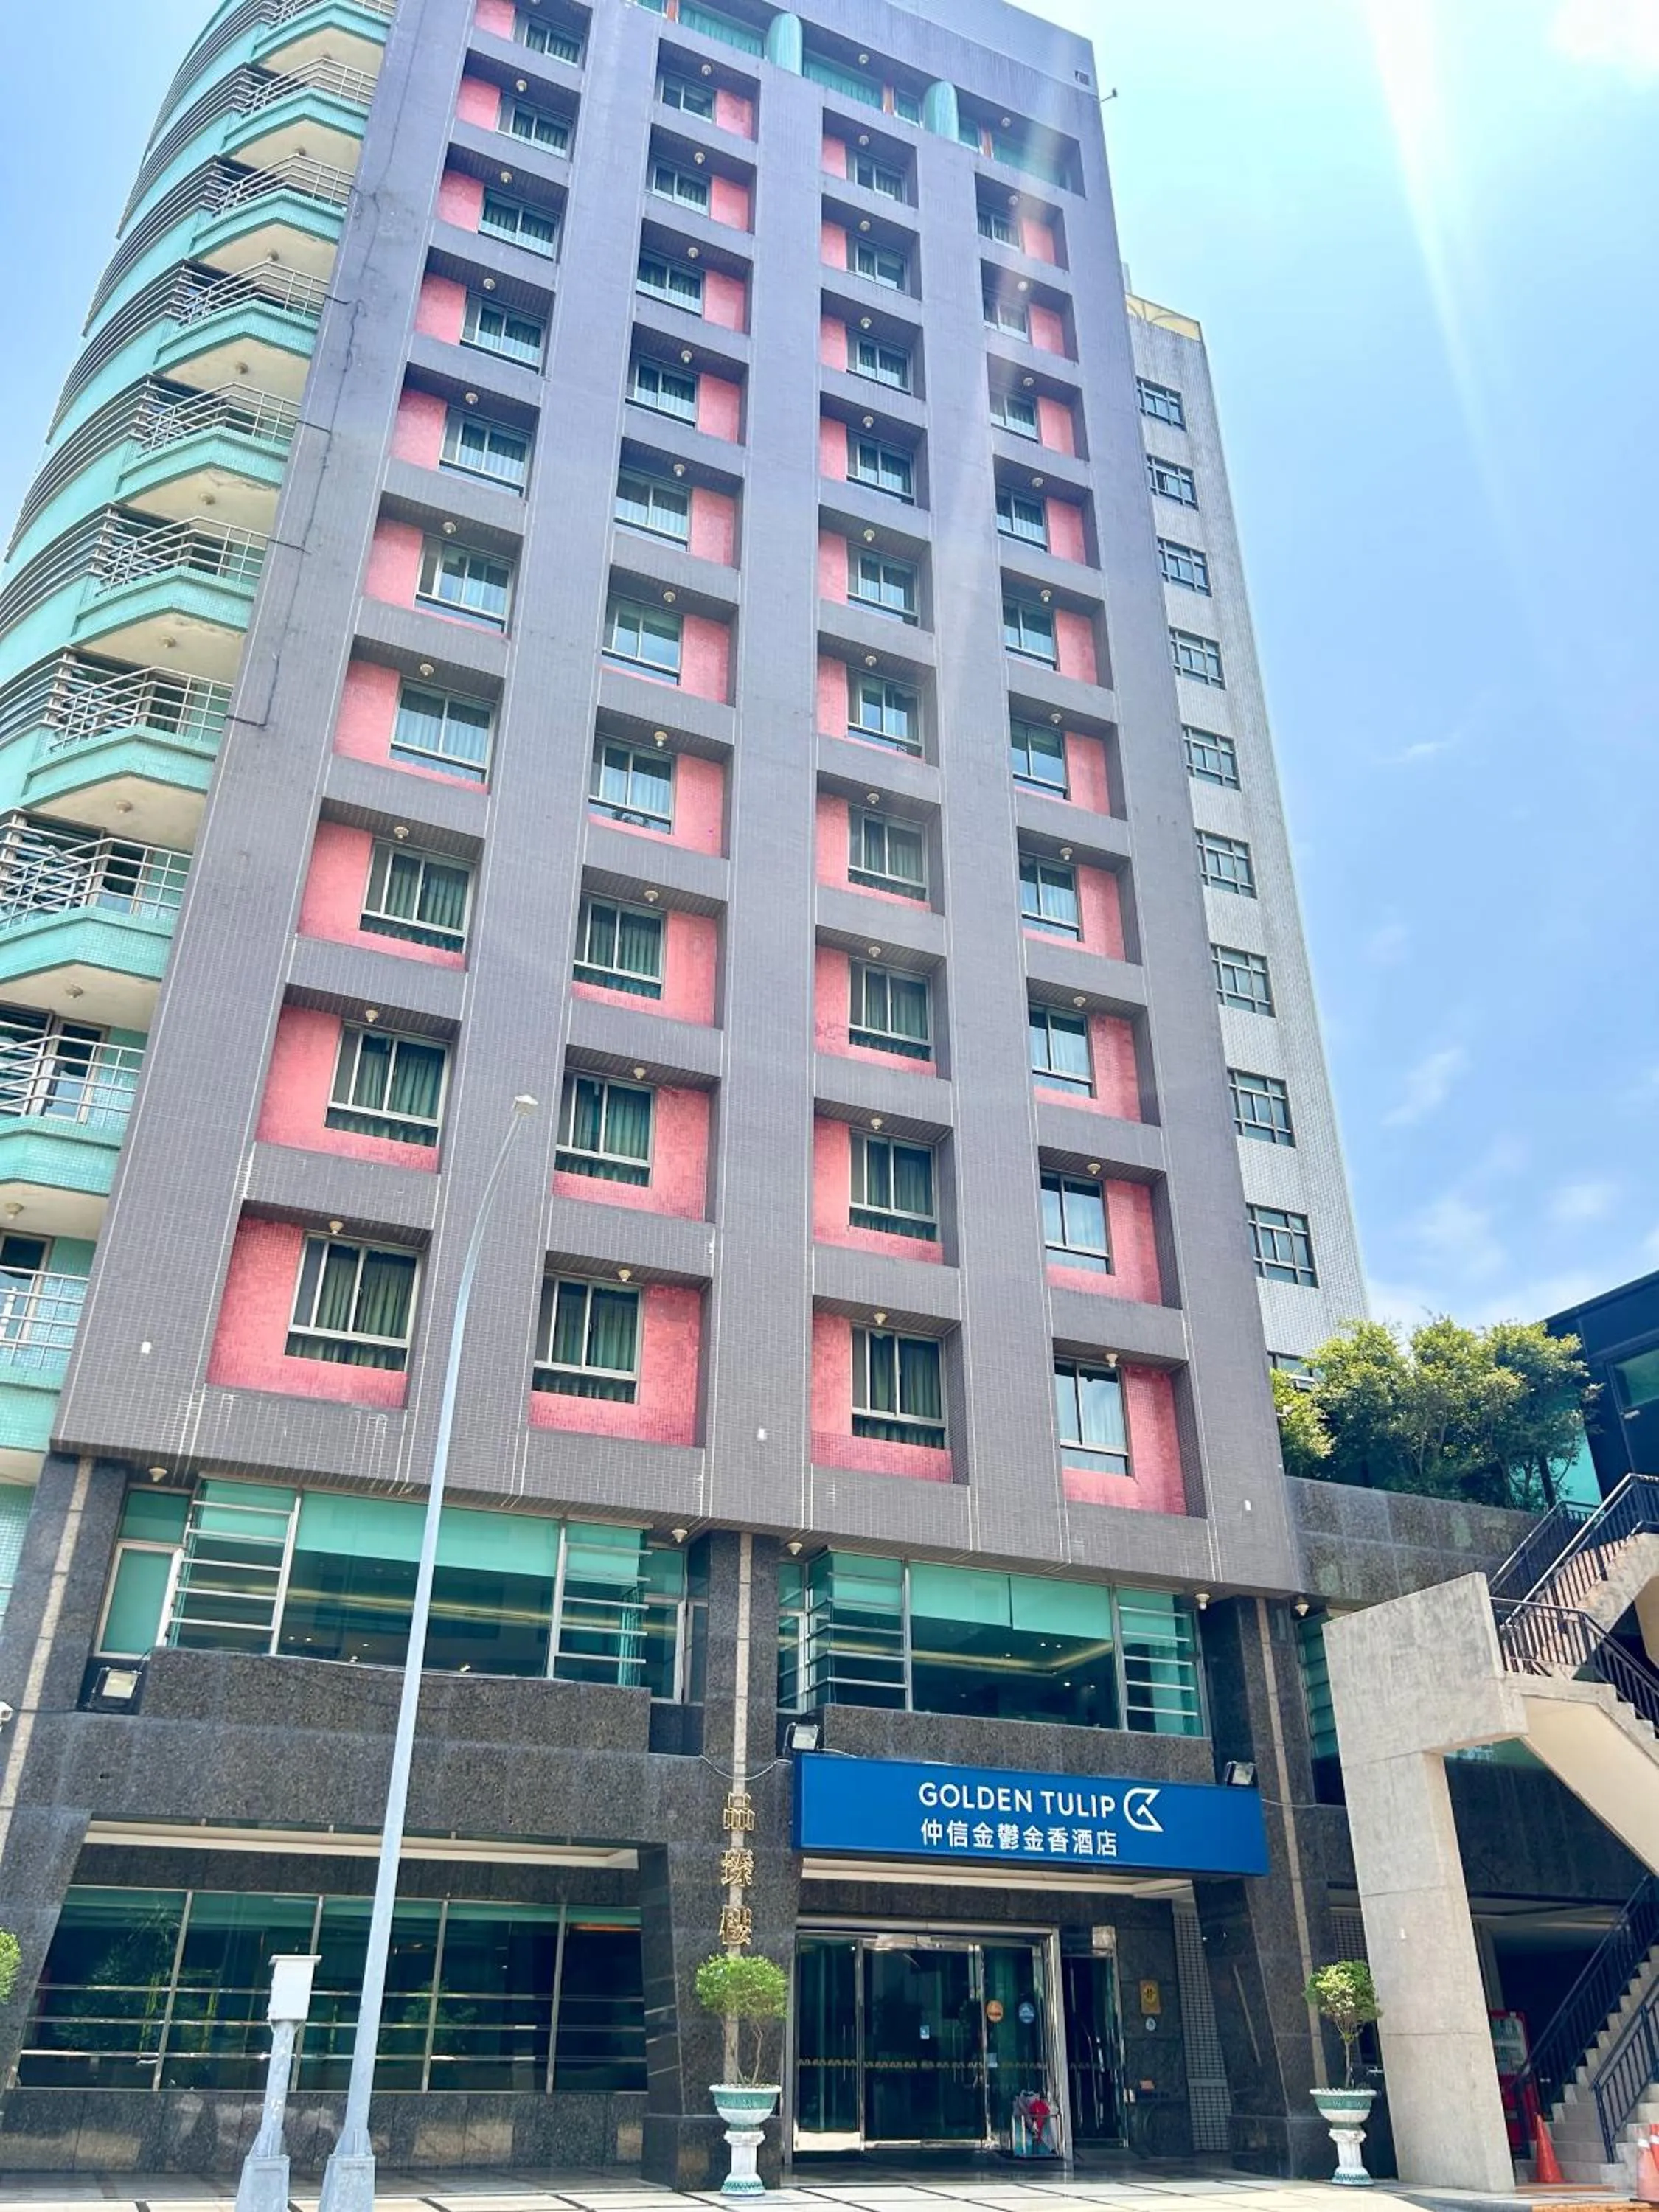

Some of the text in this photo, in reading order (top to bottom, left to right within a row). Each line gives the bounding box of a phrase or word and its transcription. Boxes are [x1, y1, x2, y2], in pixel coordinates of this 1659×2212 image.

[919, 1781, 1116, 1818] GOLDEN TULIP
[920, 1818, 1118, 1857] 仲信金鬱金香酒店
